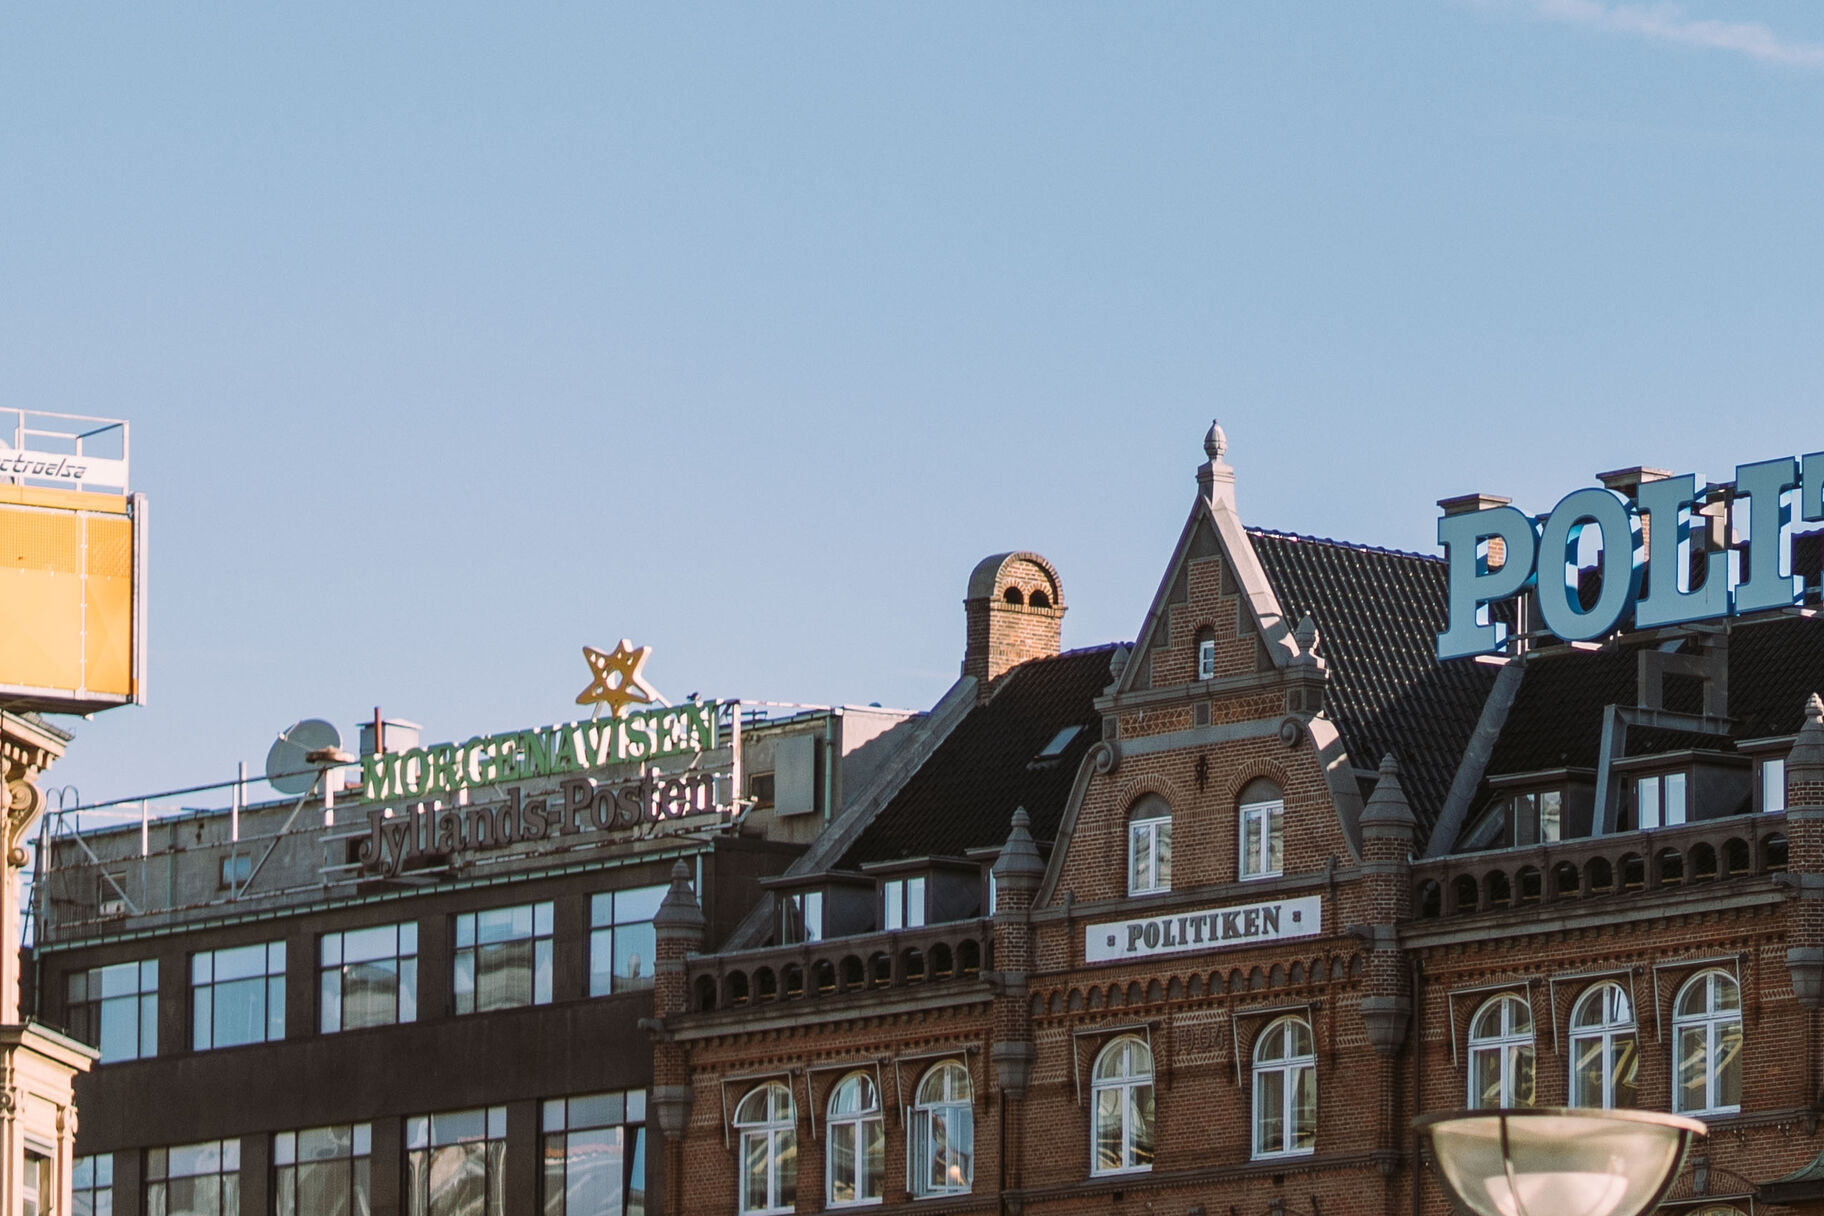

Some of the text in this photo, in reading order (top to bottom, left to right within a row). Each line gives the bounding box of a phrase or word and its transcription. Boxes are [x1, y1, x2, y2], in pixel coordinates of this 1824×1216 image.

[361, 698, 720, 802] MORGENAVISEN
[358, 767, 718, 879] Jyllands-Posten
[1126, 905, 1282, 952] POLITIKEN
